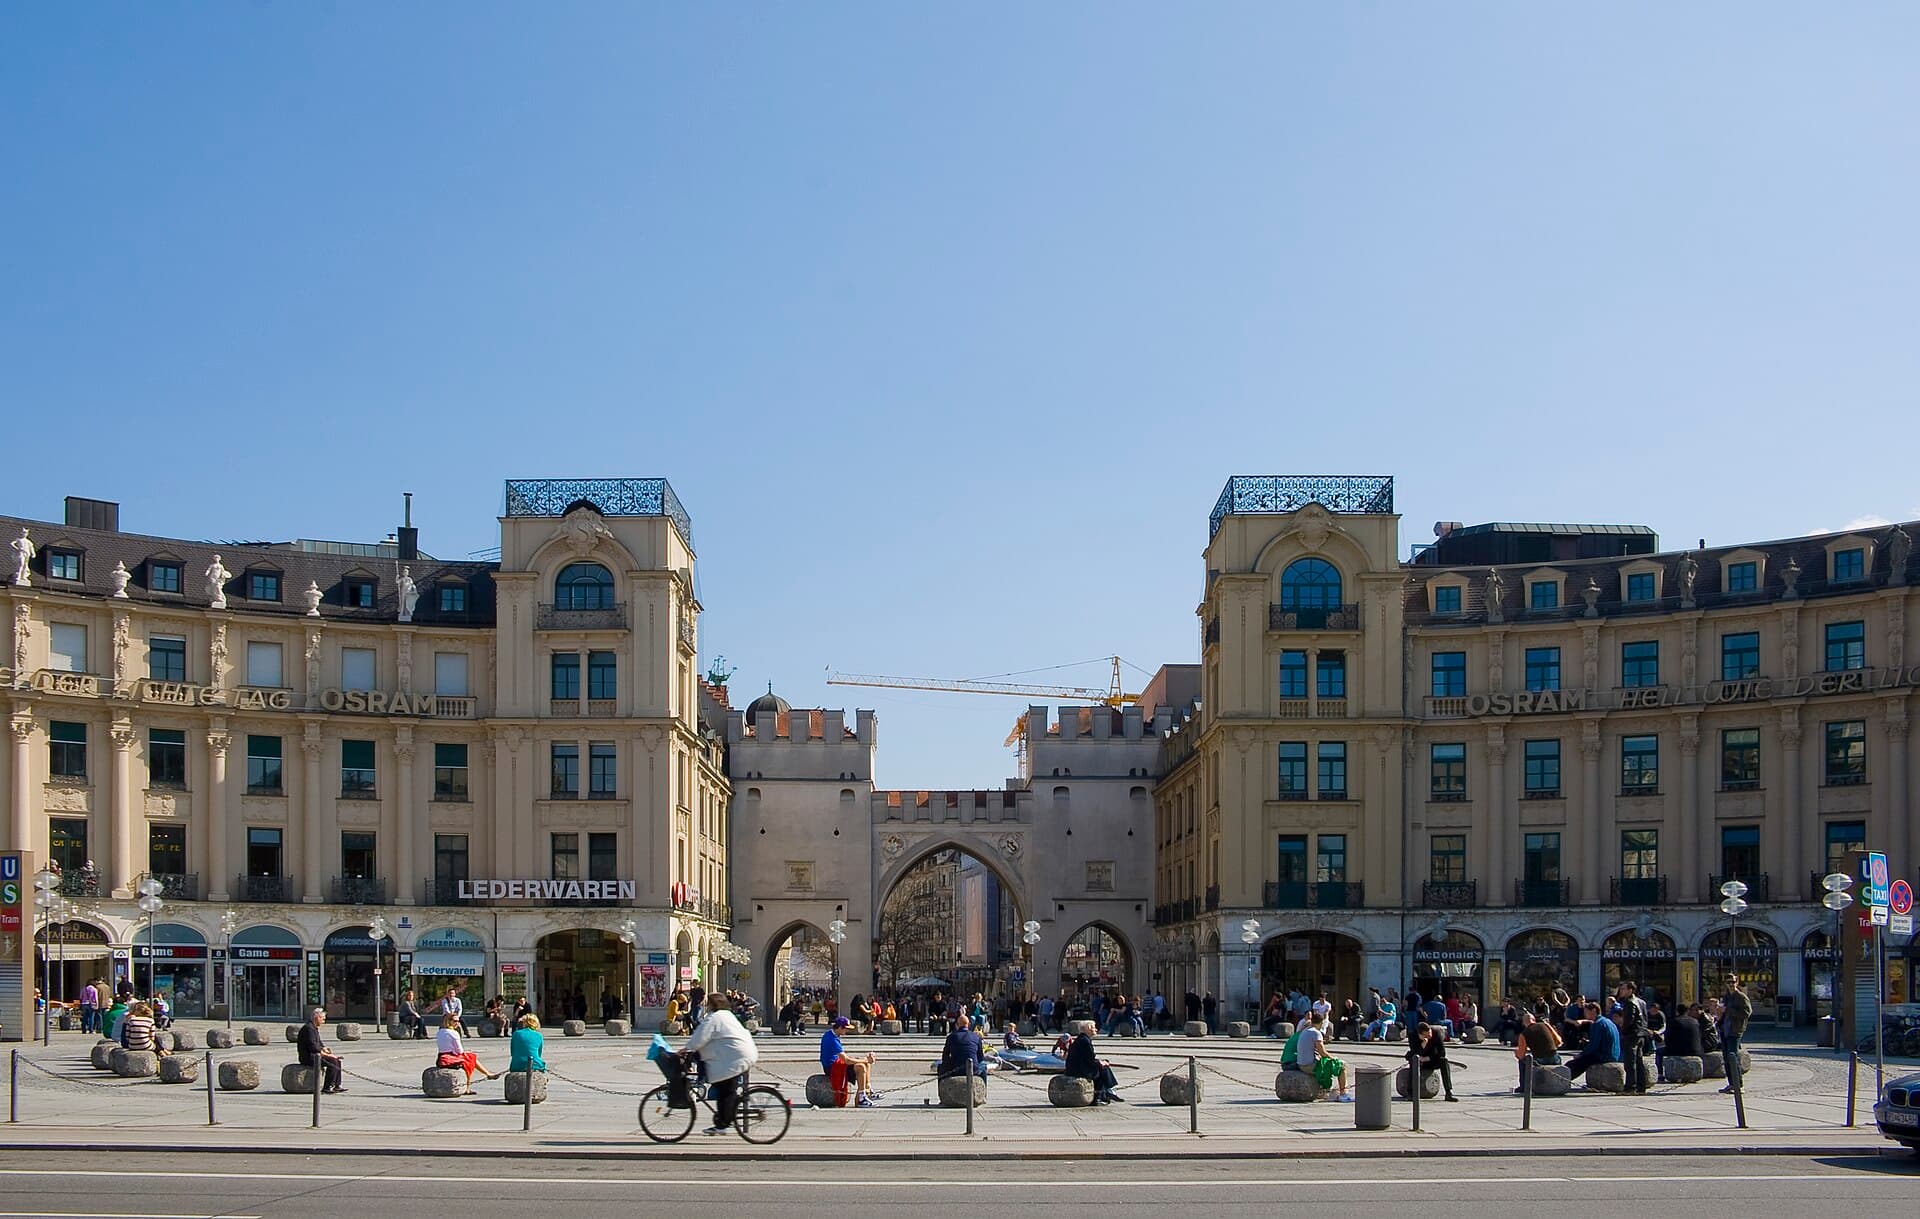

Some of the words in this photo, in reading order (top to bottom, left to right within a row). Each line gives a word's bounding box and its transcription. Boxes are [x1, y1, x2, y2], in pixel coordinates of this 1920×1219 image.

[1619, 687, 1685, 709] HELL
[1703, 679, 1772, 703] WIE
[1792, 671, 1858, 696] DER
[231, 688, 291, 709] TAG
[320, 687, 436, 715] OSRAM
[1467, 689, 1586, 716] OSRAM
[5, 860, 15, 877] U
[4, 884, 17, 904] S
[458, 880, 636, 899] LEDERWAREN
[1873, 889, 1887, 900] TAXI
[2, 914, 19, 924] Tram
[1858, 917, 1872, 927] Tra
[422, 938, 480, 948] Hetzenecker
[141, 947, 198, 957] Game
[239, 948, 295, 958] Game
[1416, 950, 1482, 960] McDonald's
[418, 966, 476, 975] Lederwaren
